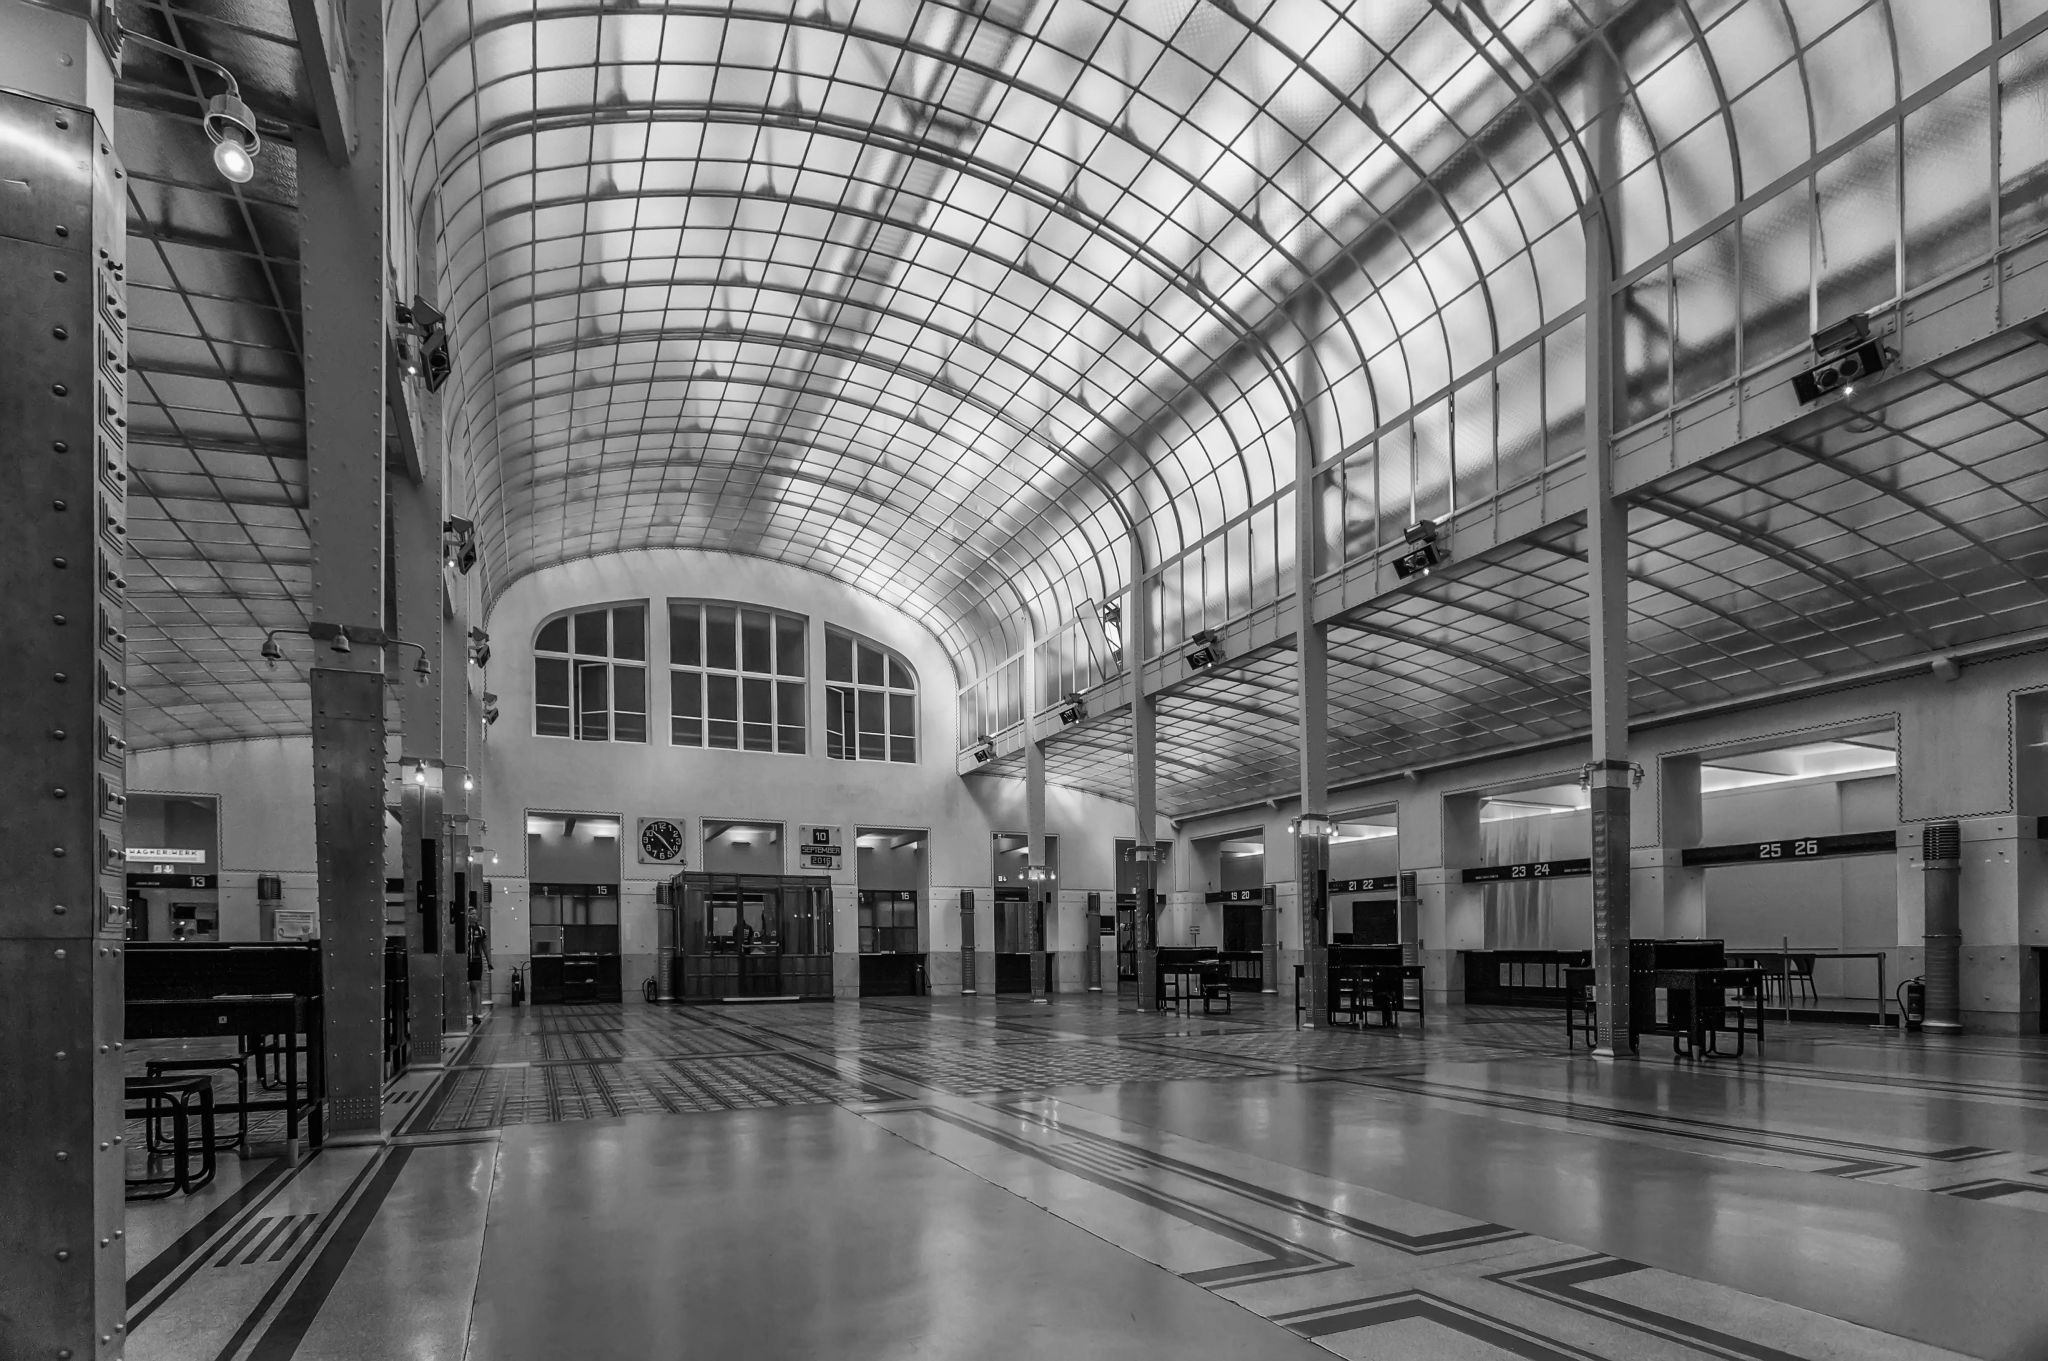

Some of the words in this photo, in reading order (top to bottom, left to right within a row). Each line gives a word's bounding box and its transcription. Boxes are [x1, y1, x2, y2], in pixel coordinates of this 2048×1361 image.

[651, 823, 658, 831] 11
[659, 822, 667, 830] 12
[668, 824, 672, 832] 1
[673, 830, 679, 838] 2
[815, 831, 827, 841] 10
[642, 836, 649, 844] 9
[675, 837, 682, 845] 3
[646, 844, 652, 852] 8
[672, 844, 679, 853] 4
[801, 846, 841, 854] SEPTEMBER
[1759, 843, 1782, 858] 25
[1794, 840, 1818, 856] 26
[659, 852, 665, 860] 6
[667, 850, 673, 858] 5
[1511, 865, 1527, 878] 23
[1534, 863, 1550, 876] 24
[189, 876, 206, 887] 13
[1348, 881, 1357, 891] 21
[1362, 879, 1374, 890] 22
[596, 885, 608, 895] 15
[900, 892, 910, 900] 16
[1231, 892, 1238, 900] 19
[1241, 891, 1250, 899] 20
